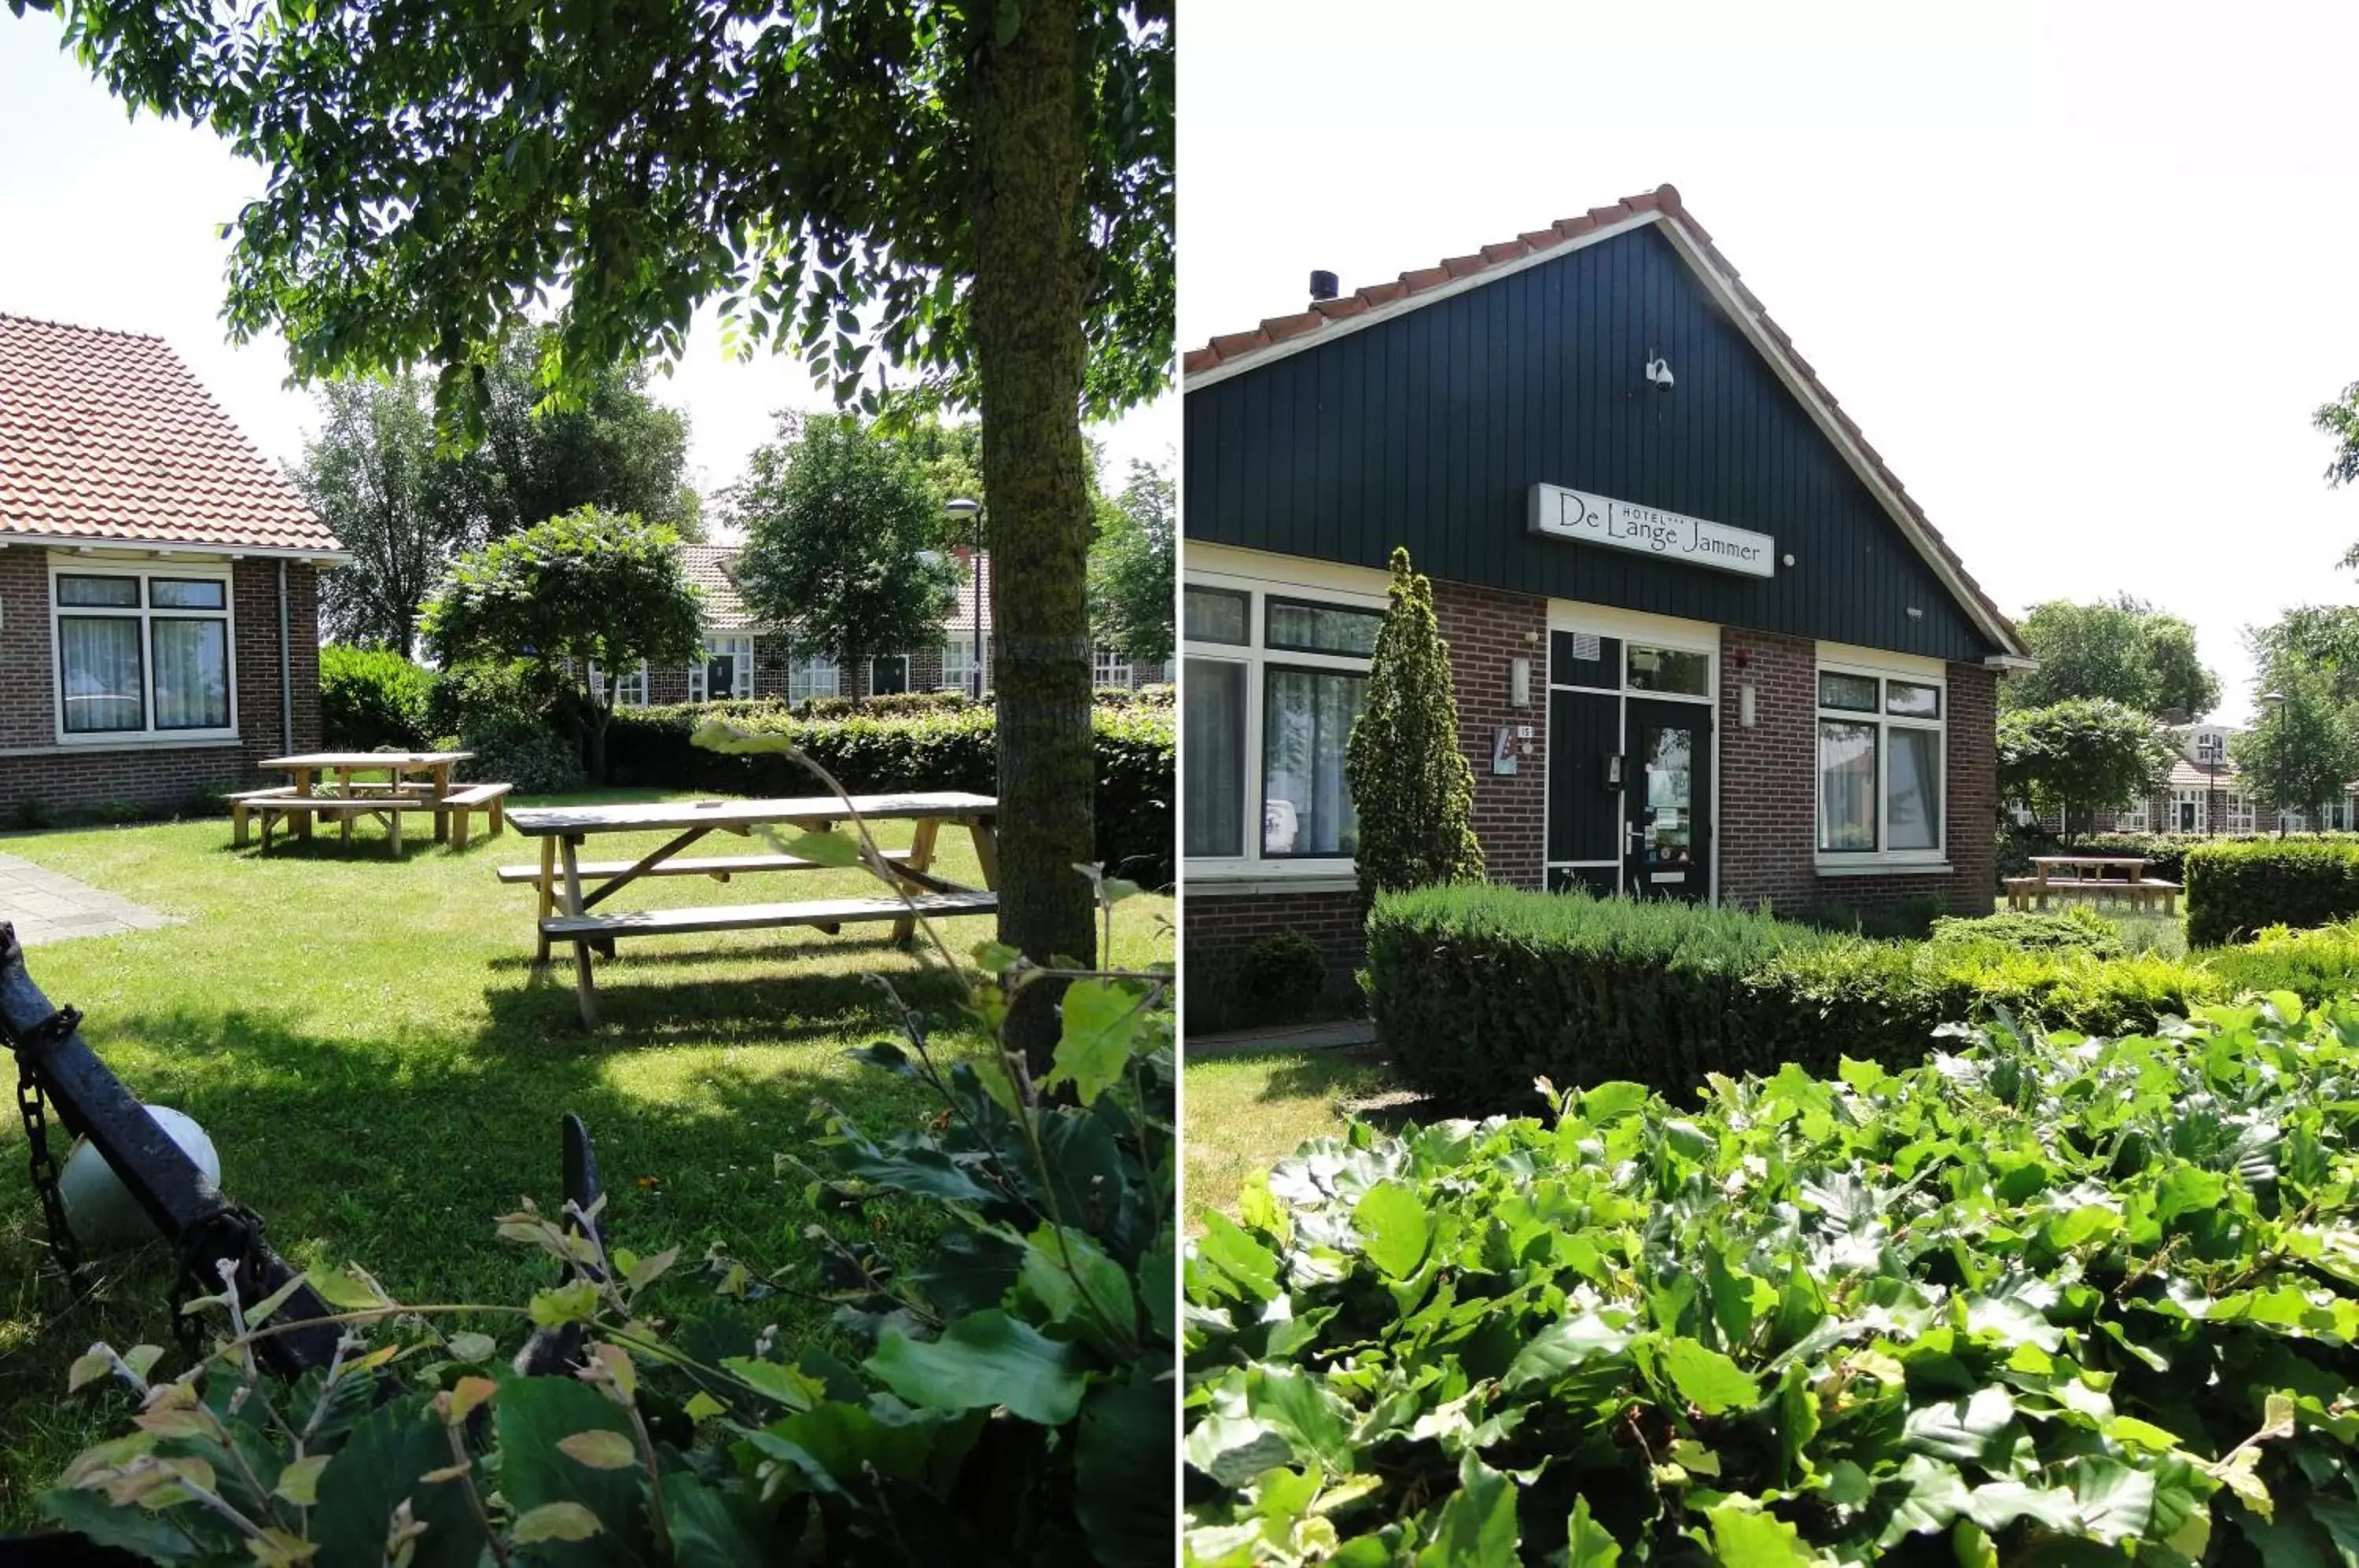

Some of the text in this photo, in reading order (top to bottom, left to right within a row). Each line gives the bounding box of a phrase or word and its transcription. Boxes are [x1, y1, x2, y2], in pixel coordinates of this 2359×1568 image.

[1560, 491, 1761, 561] De Lange Jammer
[1622, 506, 1665, 525] HOTEL
